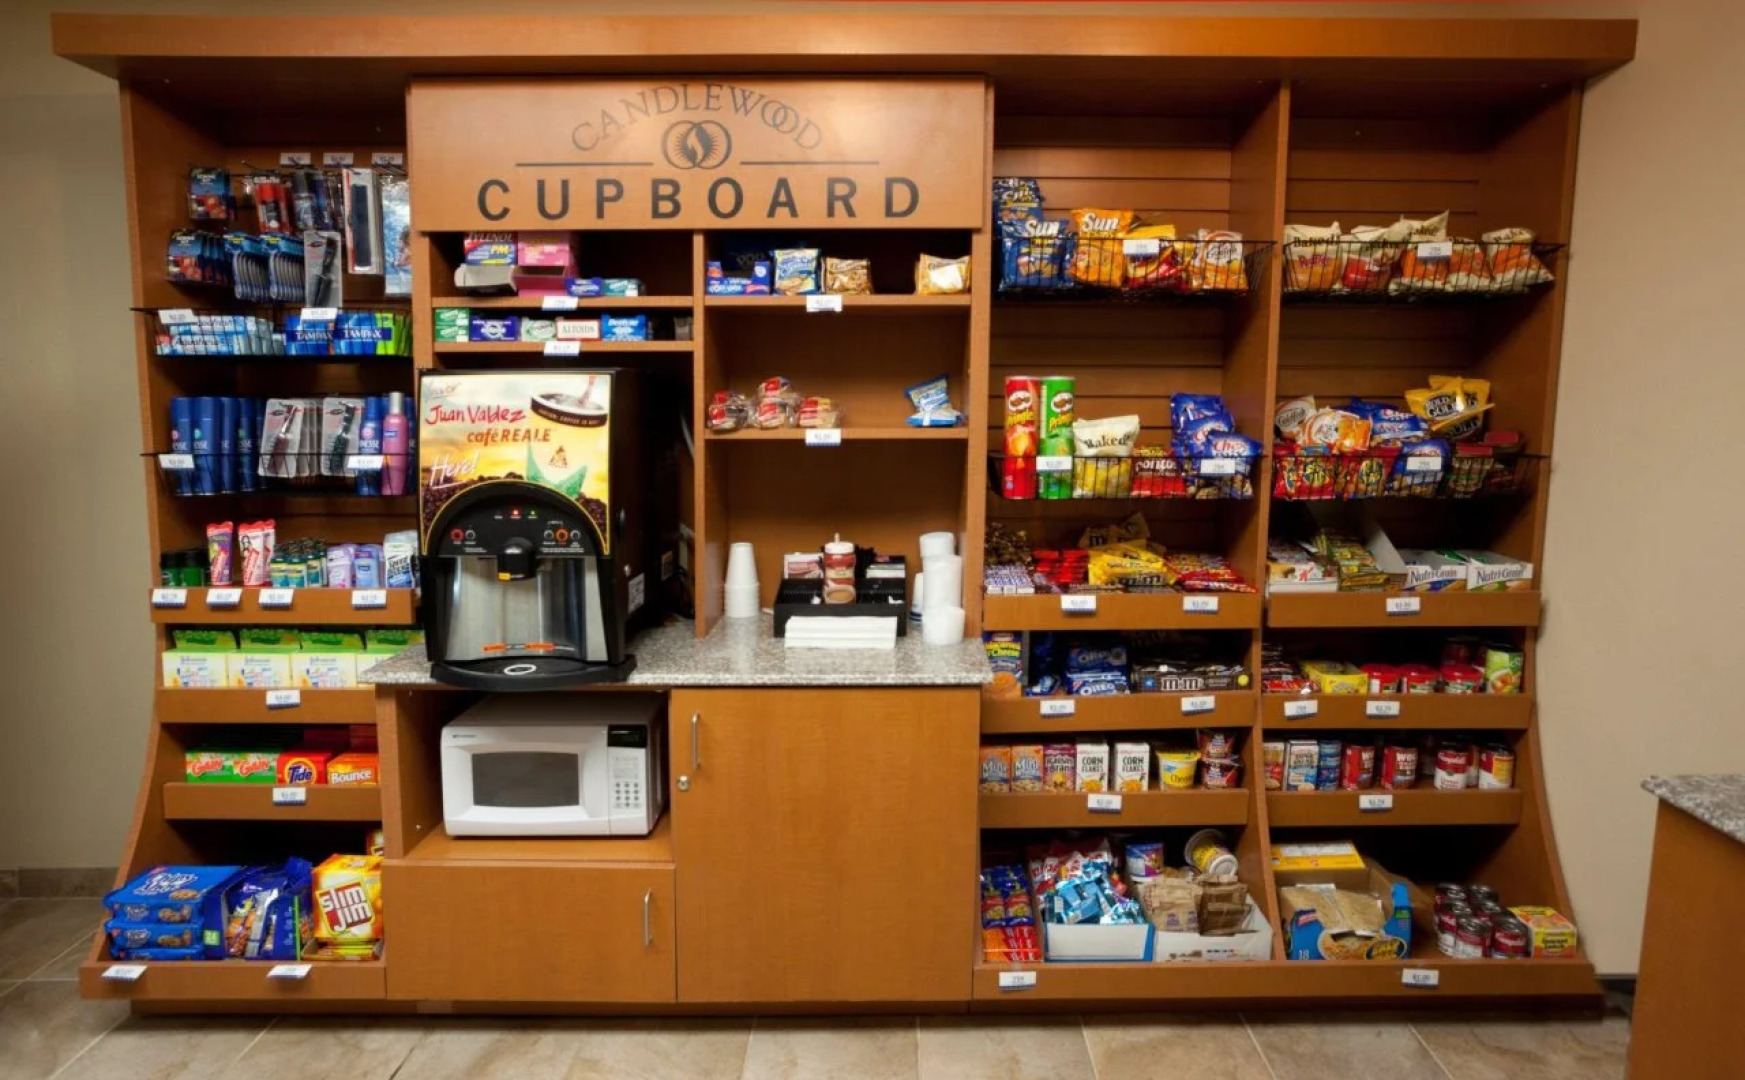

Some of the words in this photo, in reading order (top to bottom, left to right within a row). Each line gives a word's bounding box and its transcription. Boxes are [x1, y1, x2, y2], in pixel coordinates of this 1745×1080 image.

[571, 83, 824, 154] CANDLEWOOD
[477, 176, 921, 222] CUPBOARD
[1024, 219, 1060, 238] Sun
[1082, 212, 1120, 232] Sun
[296, 330, 333, 341] TAMPAX
[344, 329, 382, 339] TAMPAX
[425, 404, 465, 425] Juan
[466, 404, 526, 424] Valdez
[467, 428, 499, 447] café
[500, 428, 551, 443] REALE
[430, 452, 480, 488] Here!
[192, 757, 224, 777] Gain
[239, 757, 270, 777] Gain
[1081, 765, 1104, 773] FLAKES
[1082, 756, 1104, 765] CORN
[1122, 756, 1145, 765] CORN
[1122, 765, 1145, 773] FLAKES
[288, 765, 313, 783] Tide
[330, 768, 372, 785] Bounce
